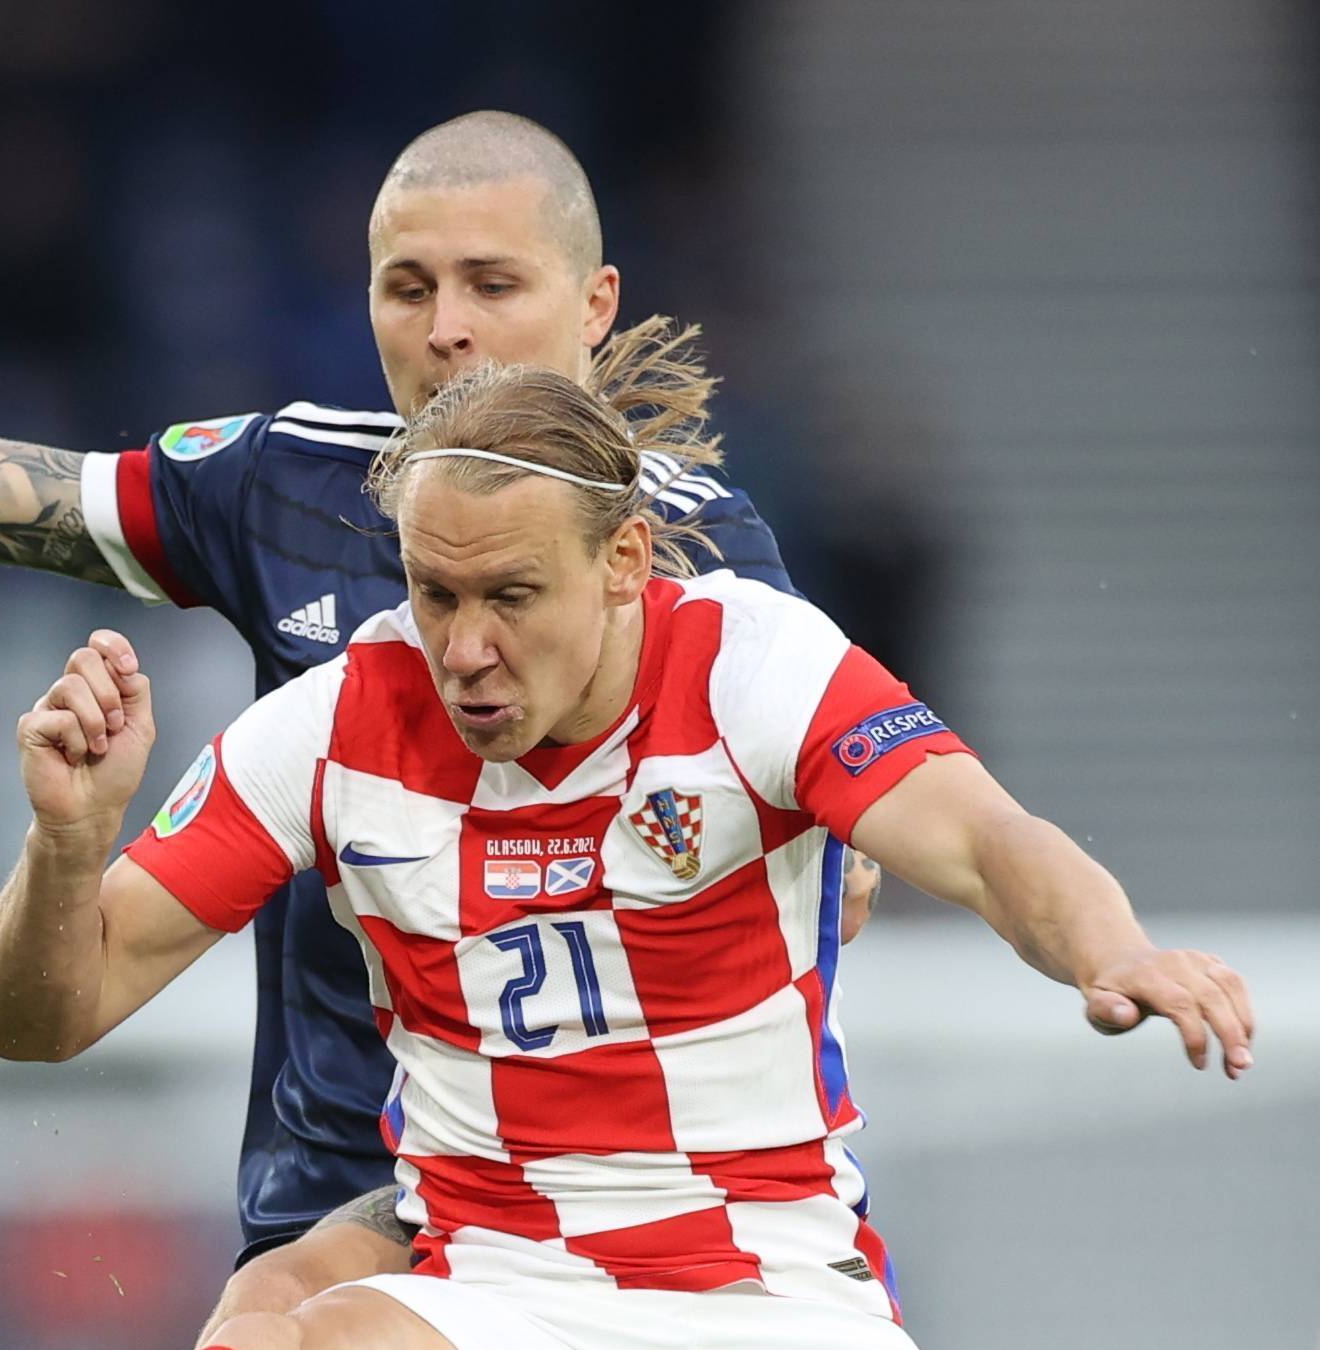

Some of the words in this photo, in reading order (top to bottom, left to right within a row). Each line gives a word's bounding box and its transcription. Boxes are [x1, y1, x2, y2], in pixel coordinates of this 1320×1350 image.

[277, 617, 340, 644] adidas
[486, 838, 544, 857] GLASGOW,
[486, 921, 610, 1052] 21
